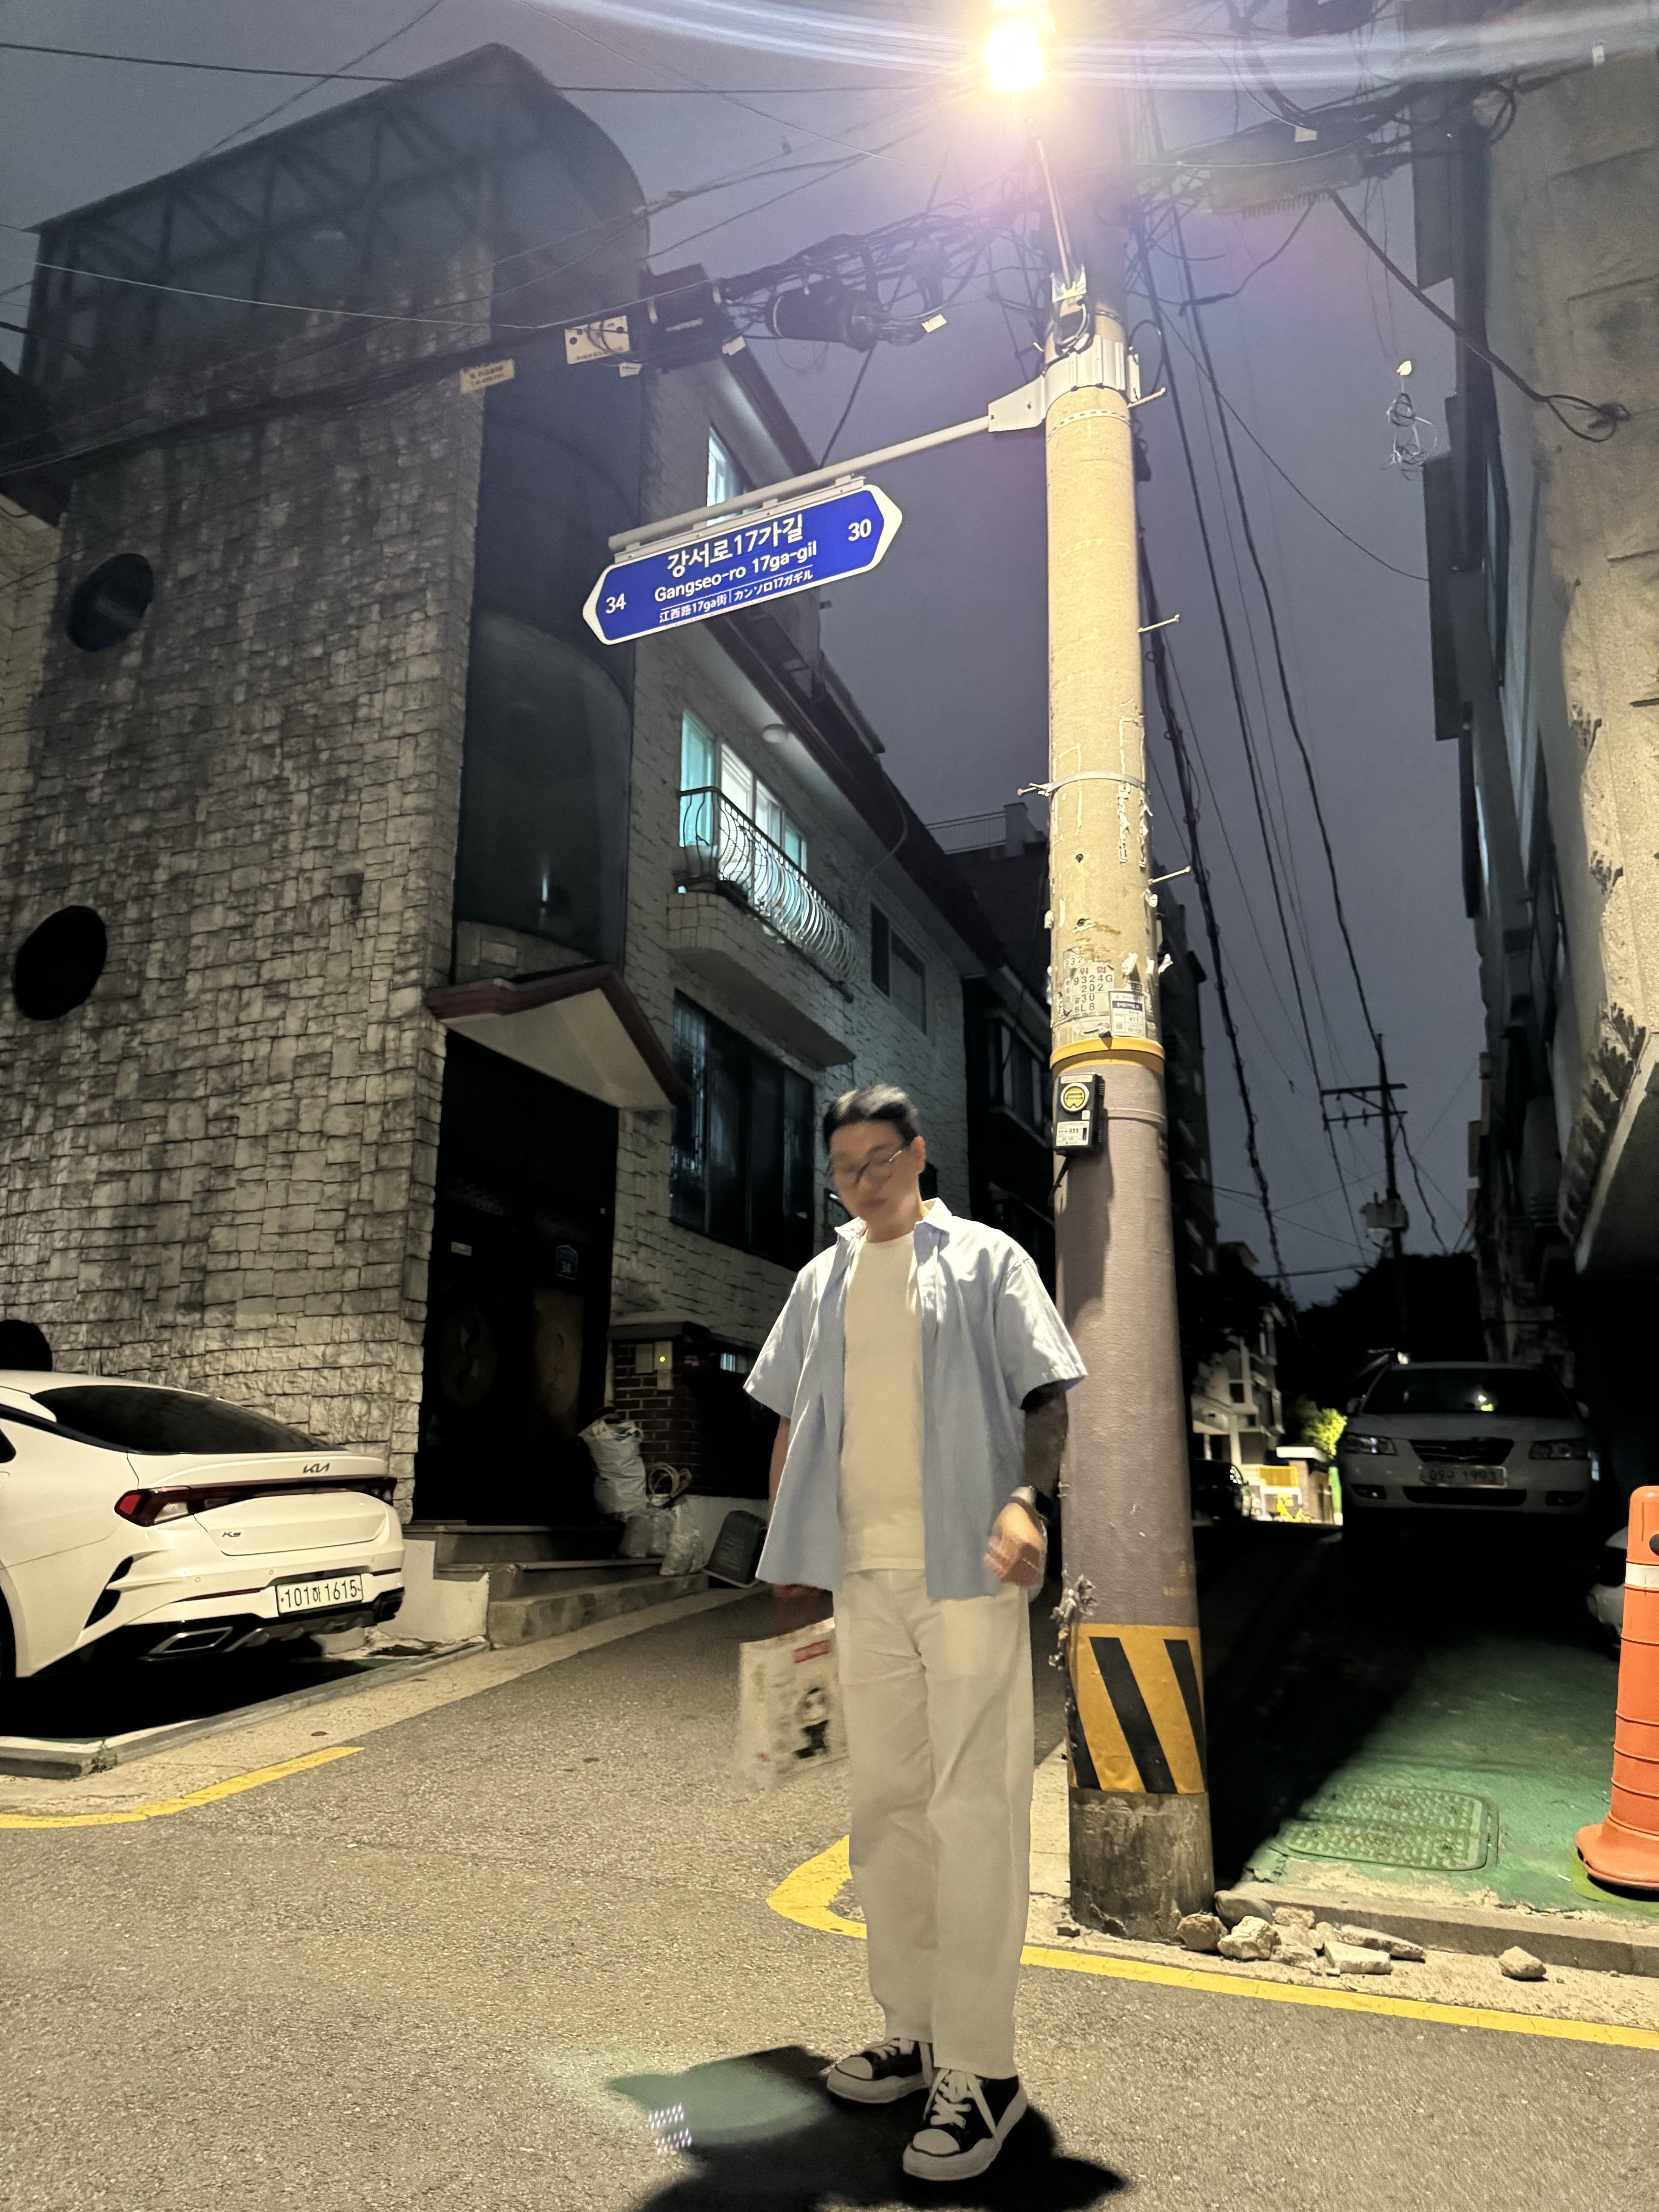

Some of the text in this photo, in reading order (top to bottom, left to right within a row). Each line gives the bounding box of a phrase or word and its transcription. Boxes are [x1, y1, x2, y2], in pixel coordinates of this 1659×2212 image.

[848, 519, 872, 541] 30
[667, 514, 803, 578] 강서로17가길
[654, 540, 817, 602] Gangseo-ro 17ga-gil
[605, 594, 626, 614] 34
[1081, 984, 1103, 993] 202
[325, 1579, 357, 1602] 1615
